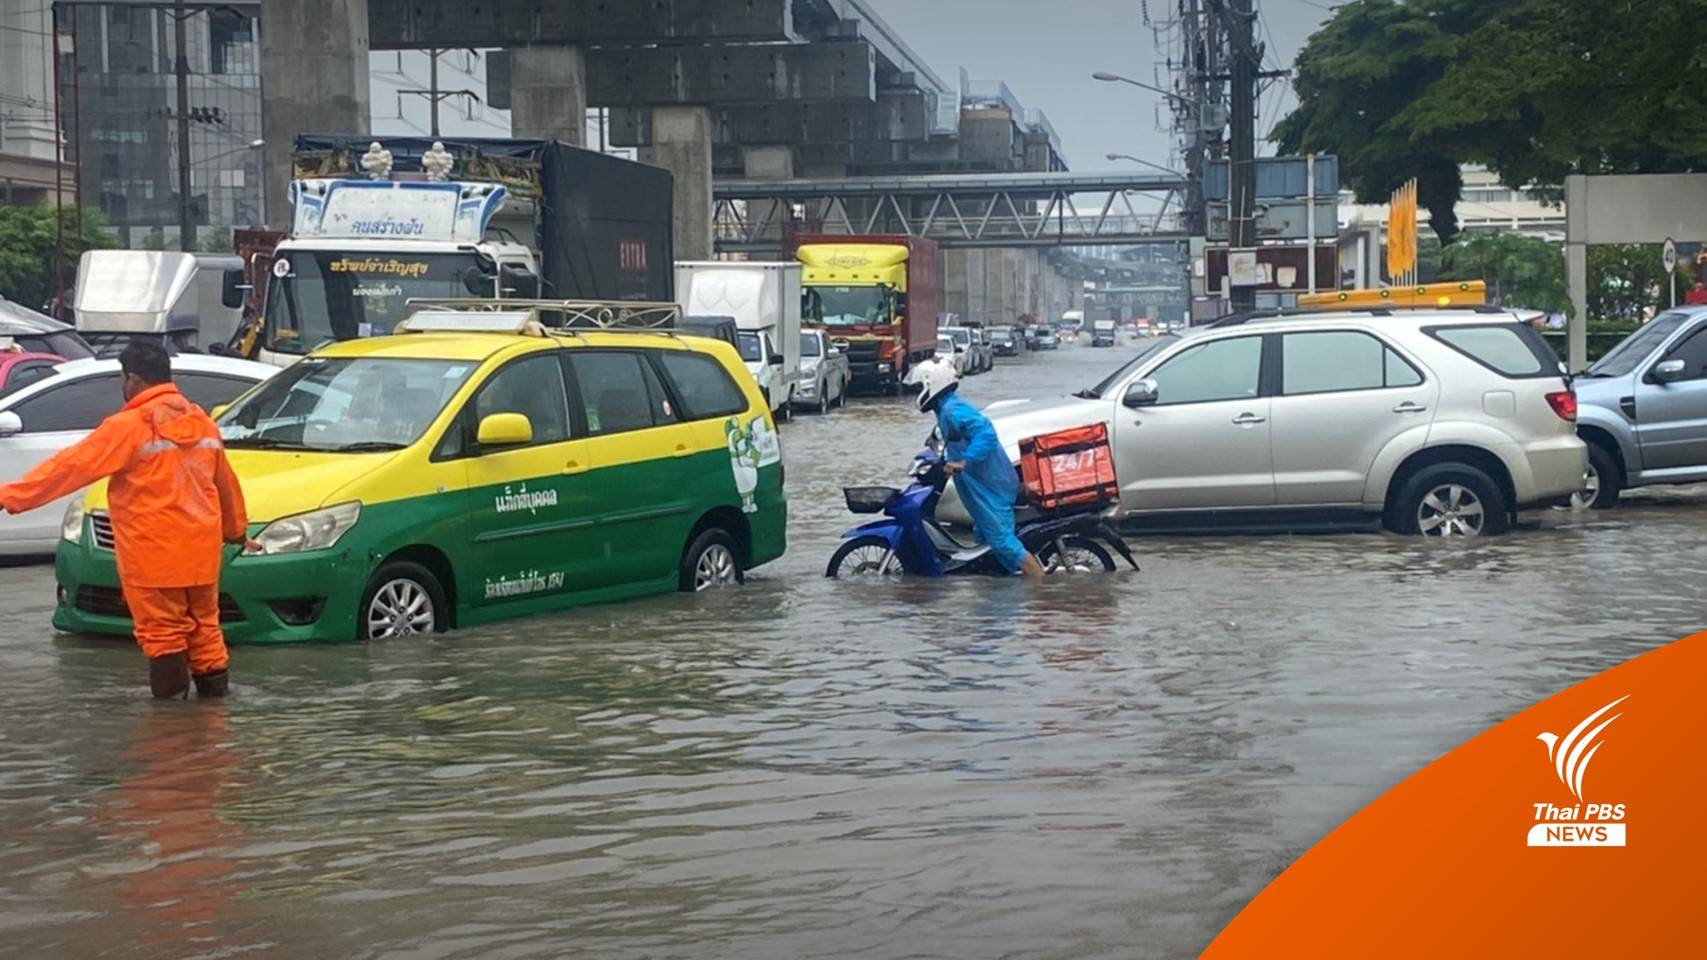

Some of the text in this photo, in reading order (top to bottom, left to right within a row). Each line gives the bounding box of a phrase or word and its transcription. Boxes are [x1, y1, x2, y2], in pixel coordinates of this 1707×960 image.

[351, 217, 425, 235] คนสร้างฝัน
[1053, 449, 1095, 473] 24/7
[495, 482, 558, 516] แท็กซี่บุคคล
